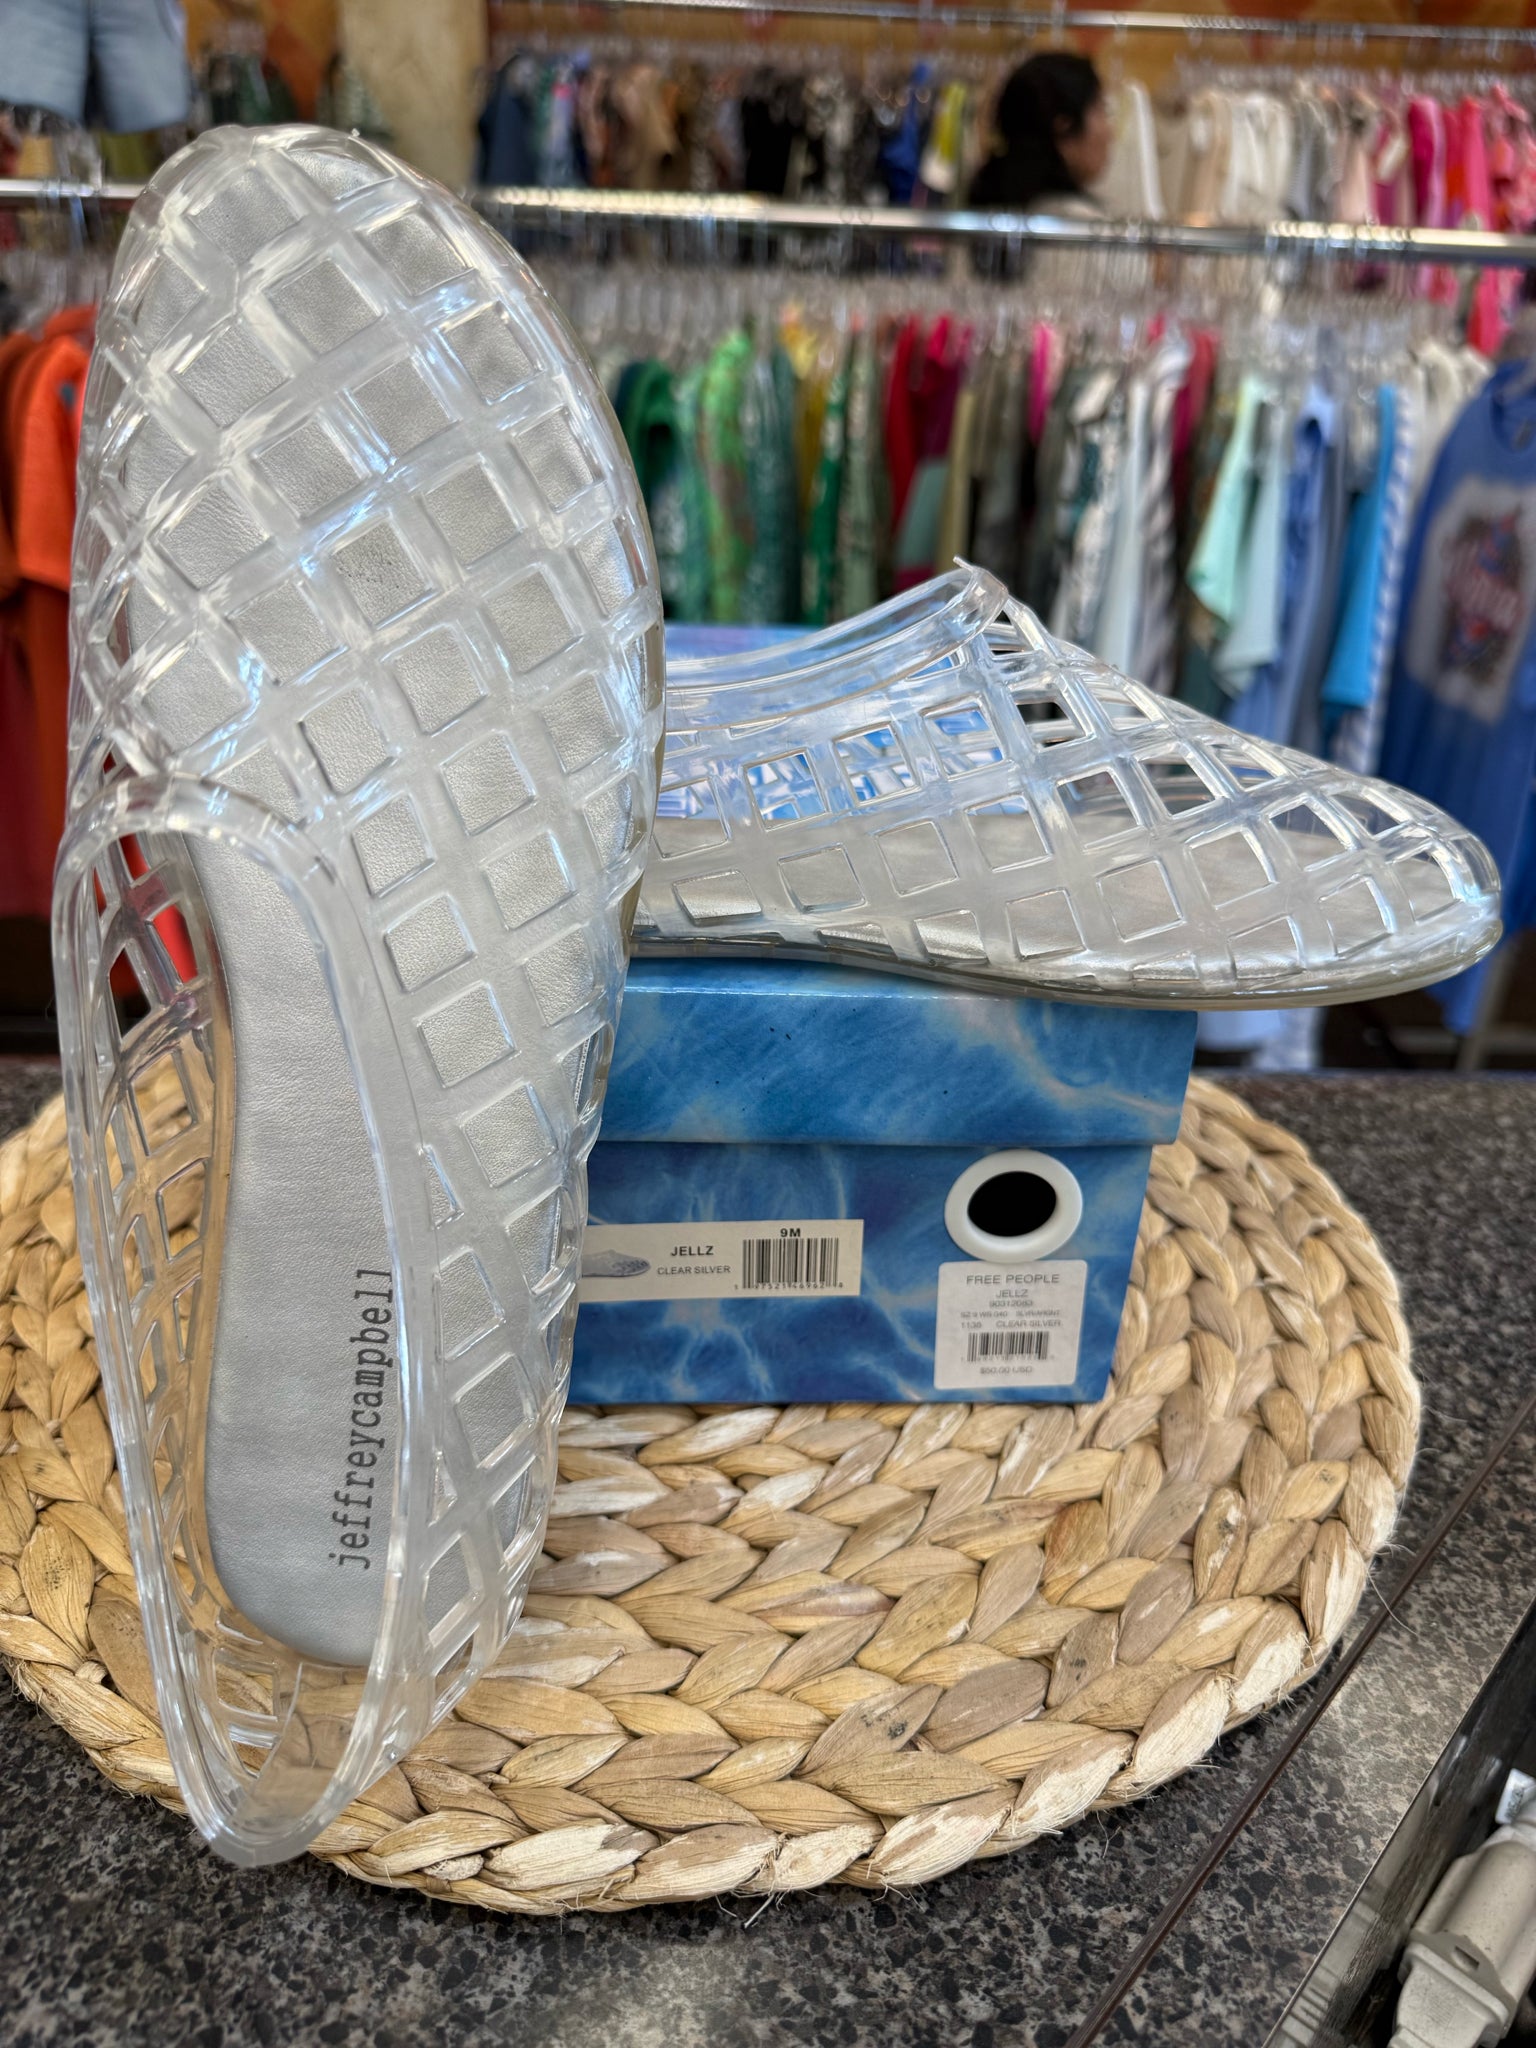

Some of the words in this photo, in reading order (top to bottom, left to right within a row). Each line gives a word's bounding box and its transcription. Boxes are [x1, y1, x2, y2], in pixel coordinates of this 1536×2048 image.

[780, 1228, 801, 1238] 9M
[670, 1245, 714, 1257] JELLZ
[657, 1266, 692, 1276] CLEAR
[694, 1264, 731, 1274] SILVER
[966, 1274, 1001, 1285] FREE
[1005, 1273, 1060, 1284] PEOPLE
[995, 1289, 1028, 1298] JELLZ
[995, 1320, 1027, 1328] CLEAR
[1029, 1320, 1061, 1328] SILVER
[328, 1268, 393, 1570] jeffreycampbell
